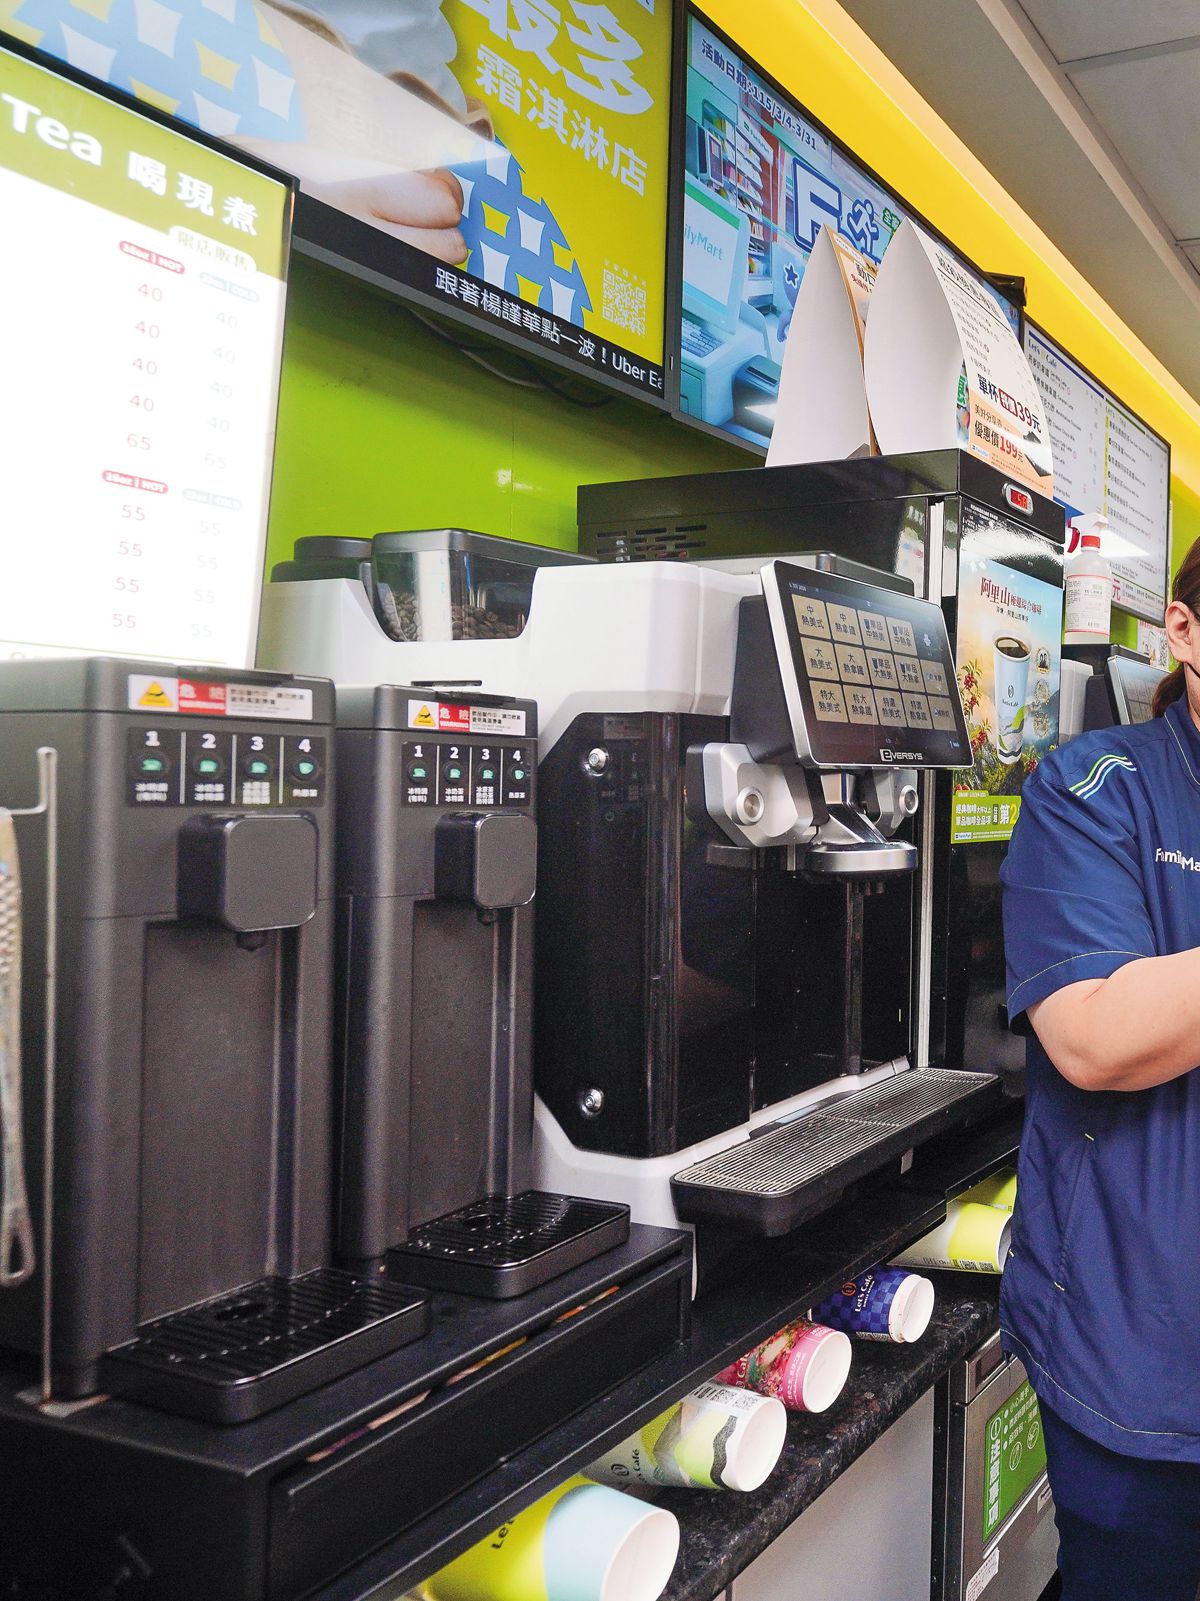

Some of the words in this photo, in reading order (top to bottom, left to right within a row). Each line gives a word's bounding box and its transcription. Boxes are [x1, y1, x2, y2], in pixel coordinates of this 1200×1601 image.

[475, 43, 647, 197] 霜淇淋店
[2, 94, 102, 166] Tea
[128, 151, 258, 235] 喝現煮
[137, 283, 163, 302] 40
[134, 320, 160, 339] 40
[132, 357, 158, 376] 40
[612, 352, 646, 381] Uber
[129, 394, 155, 412] 40
[126, 433, 151, 451] 65
[975, 420, 1024, 462] 優惠價199元
[120, 504, 146, 521] 55
[117, 540, 143, 557] 55
[114, 576, 140, 593] 55
[111, 613, 137, 629] 55
[815, 647, 823, 657] 大
[848, 652, 856, 663] 大
[146, 731, 160, 746] 1
[202, 733, 216, 749] 2
[251, 736, 264, 750] 3
[299, 738, 311, 753] 4
[414, 745, 423, 757] 1
[450, 747, 459, 759] 2
[482, 749, 490, 760] 3
[513, 750, 521, 761] 4
